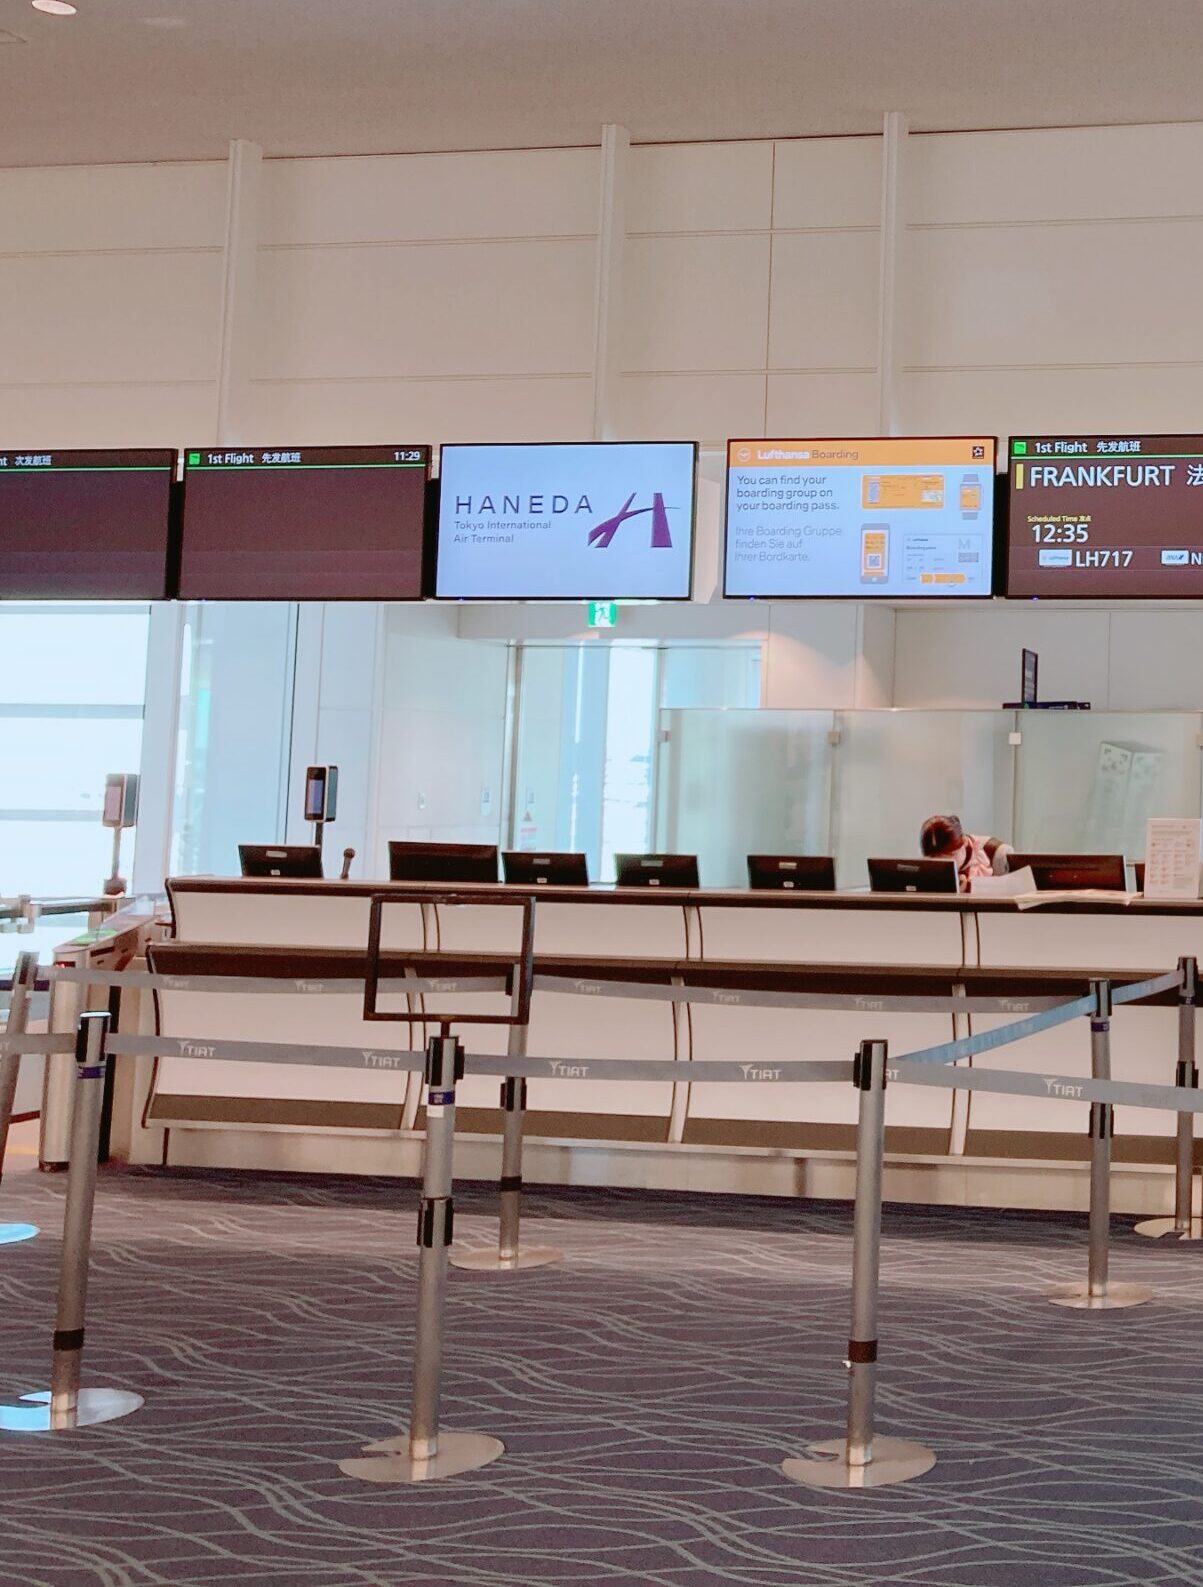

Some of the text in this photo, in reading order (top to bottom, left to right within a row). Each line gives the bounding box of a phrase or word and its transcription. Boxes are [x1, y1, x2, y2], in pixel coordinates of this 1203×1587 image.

[1034, 441, 1088, 454] 1st Flight
[207, 453, 254, 464] 1st Flight
[394, 451, 420, 461] 11:29
[812, 449, 859, 460] Boarding
[737, 475, 827, 487] You can find your
[1030, 465, 1175, 487] FRANKFURT
[737, 488, 787, 499] boarding
[789, 489, 817, 500] group
[455, 495, 593, 514] HANEDA
[737, 500, 840, 512] your boarding pass.
[454, 520, 551, 532] Tokyo International
[736, 526, 842, 538] Ihre Boarding Gruppe
[453, 534, 514, 543] Air Terminal
[1032, 524, 1089, 543] 12:35
[736, 538, 803, 549] finden Sie auf
[735, 552, 757, 562] Ihrer
[1075, 551, 1133, 567] LH717
